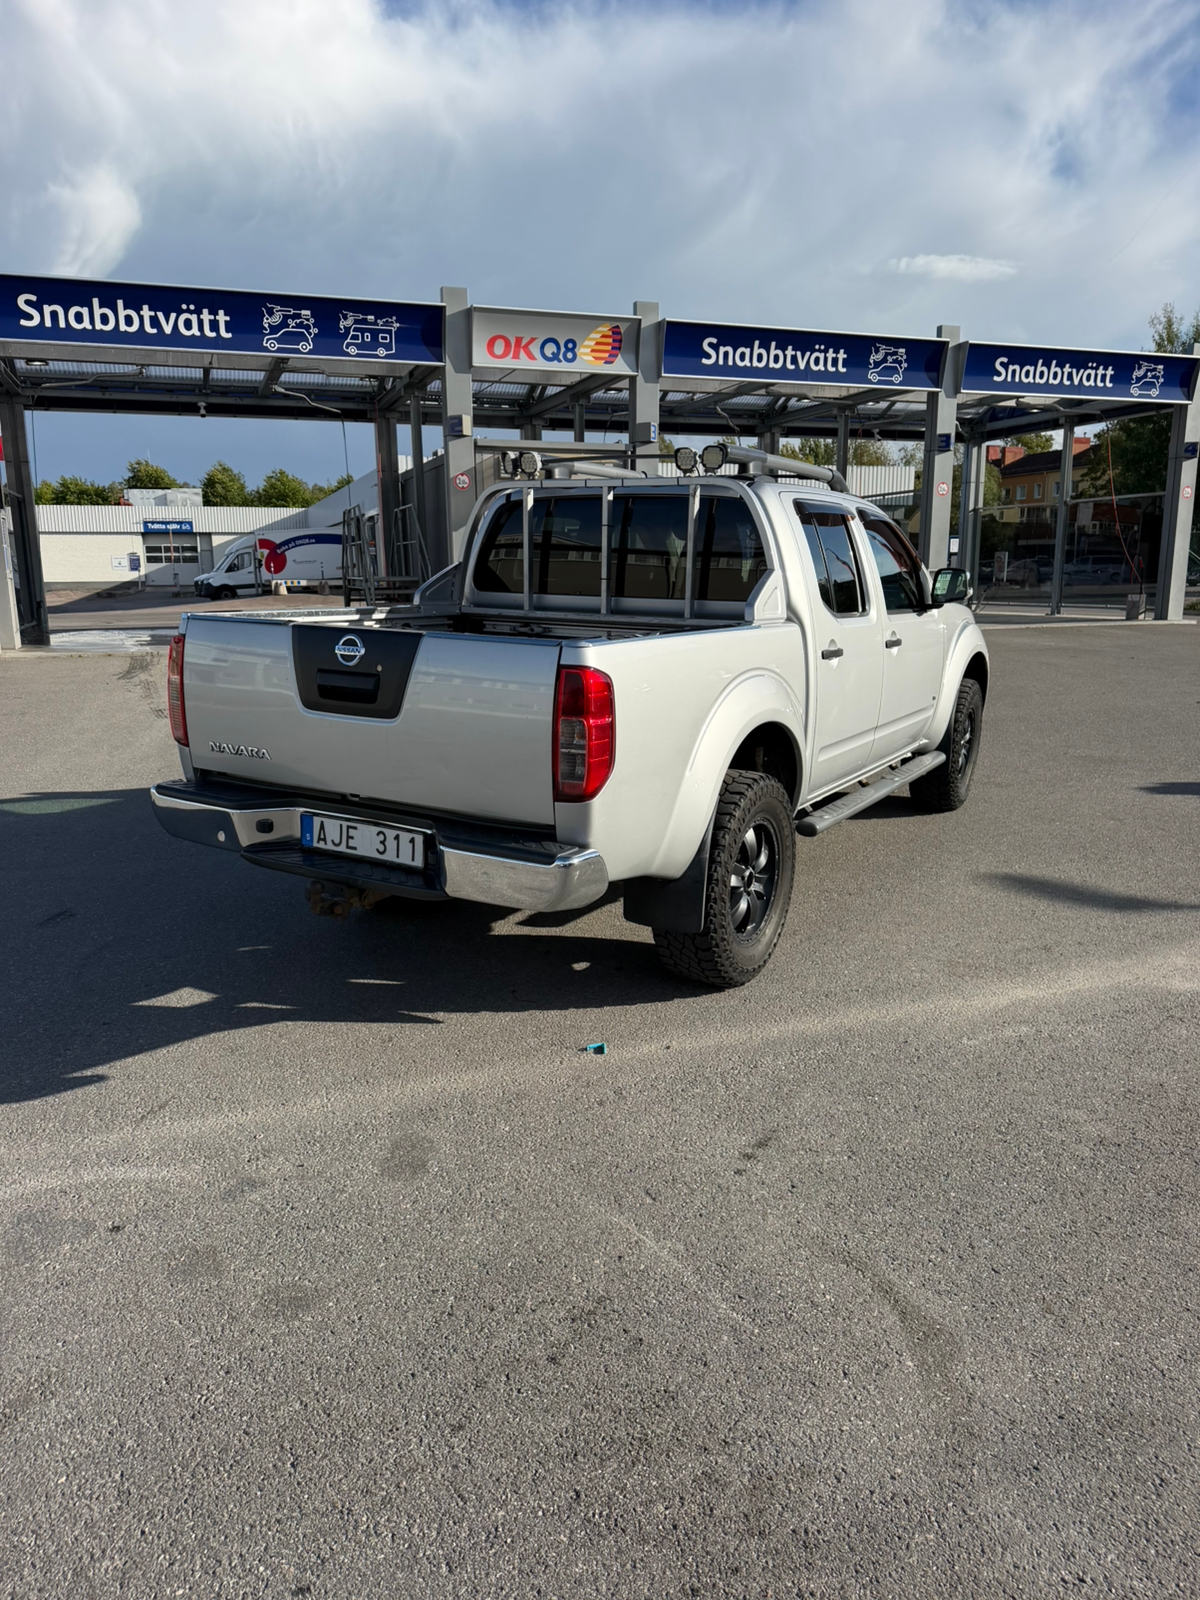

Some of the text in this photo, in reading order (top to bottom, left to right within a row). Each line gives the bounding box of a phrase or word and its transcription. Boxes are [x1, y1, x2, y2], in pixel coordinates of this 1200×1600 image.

[17, 293, 233, 338] Snabbtvätt
[486, 334, 578, 363] OKQ8
[701, 337, 848, 372] Snabbtvätt
[993, 357, 1114, 387] Snabbtvätt
[651, 423, 657, 440] 3
[938, 435, 951, 449] 3
[1184, 443, 1198, 456] 4
[336, 646, 362, 654] NISSAN
[209, 741, 272, 761] NAVARA
[316, 820, 415, 862] AJE 311
